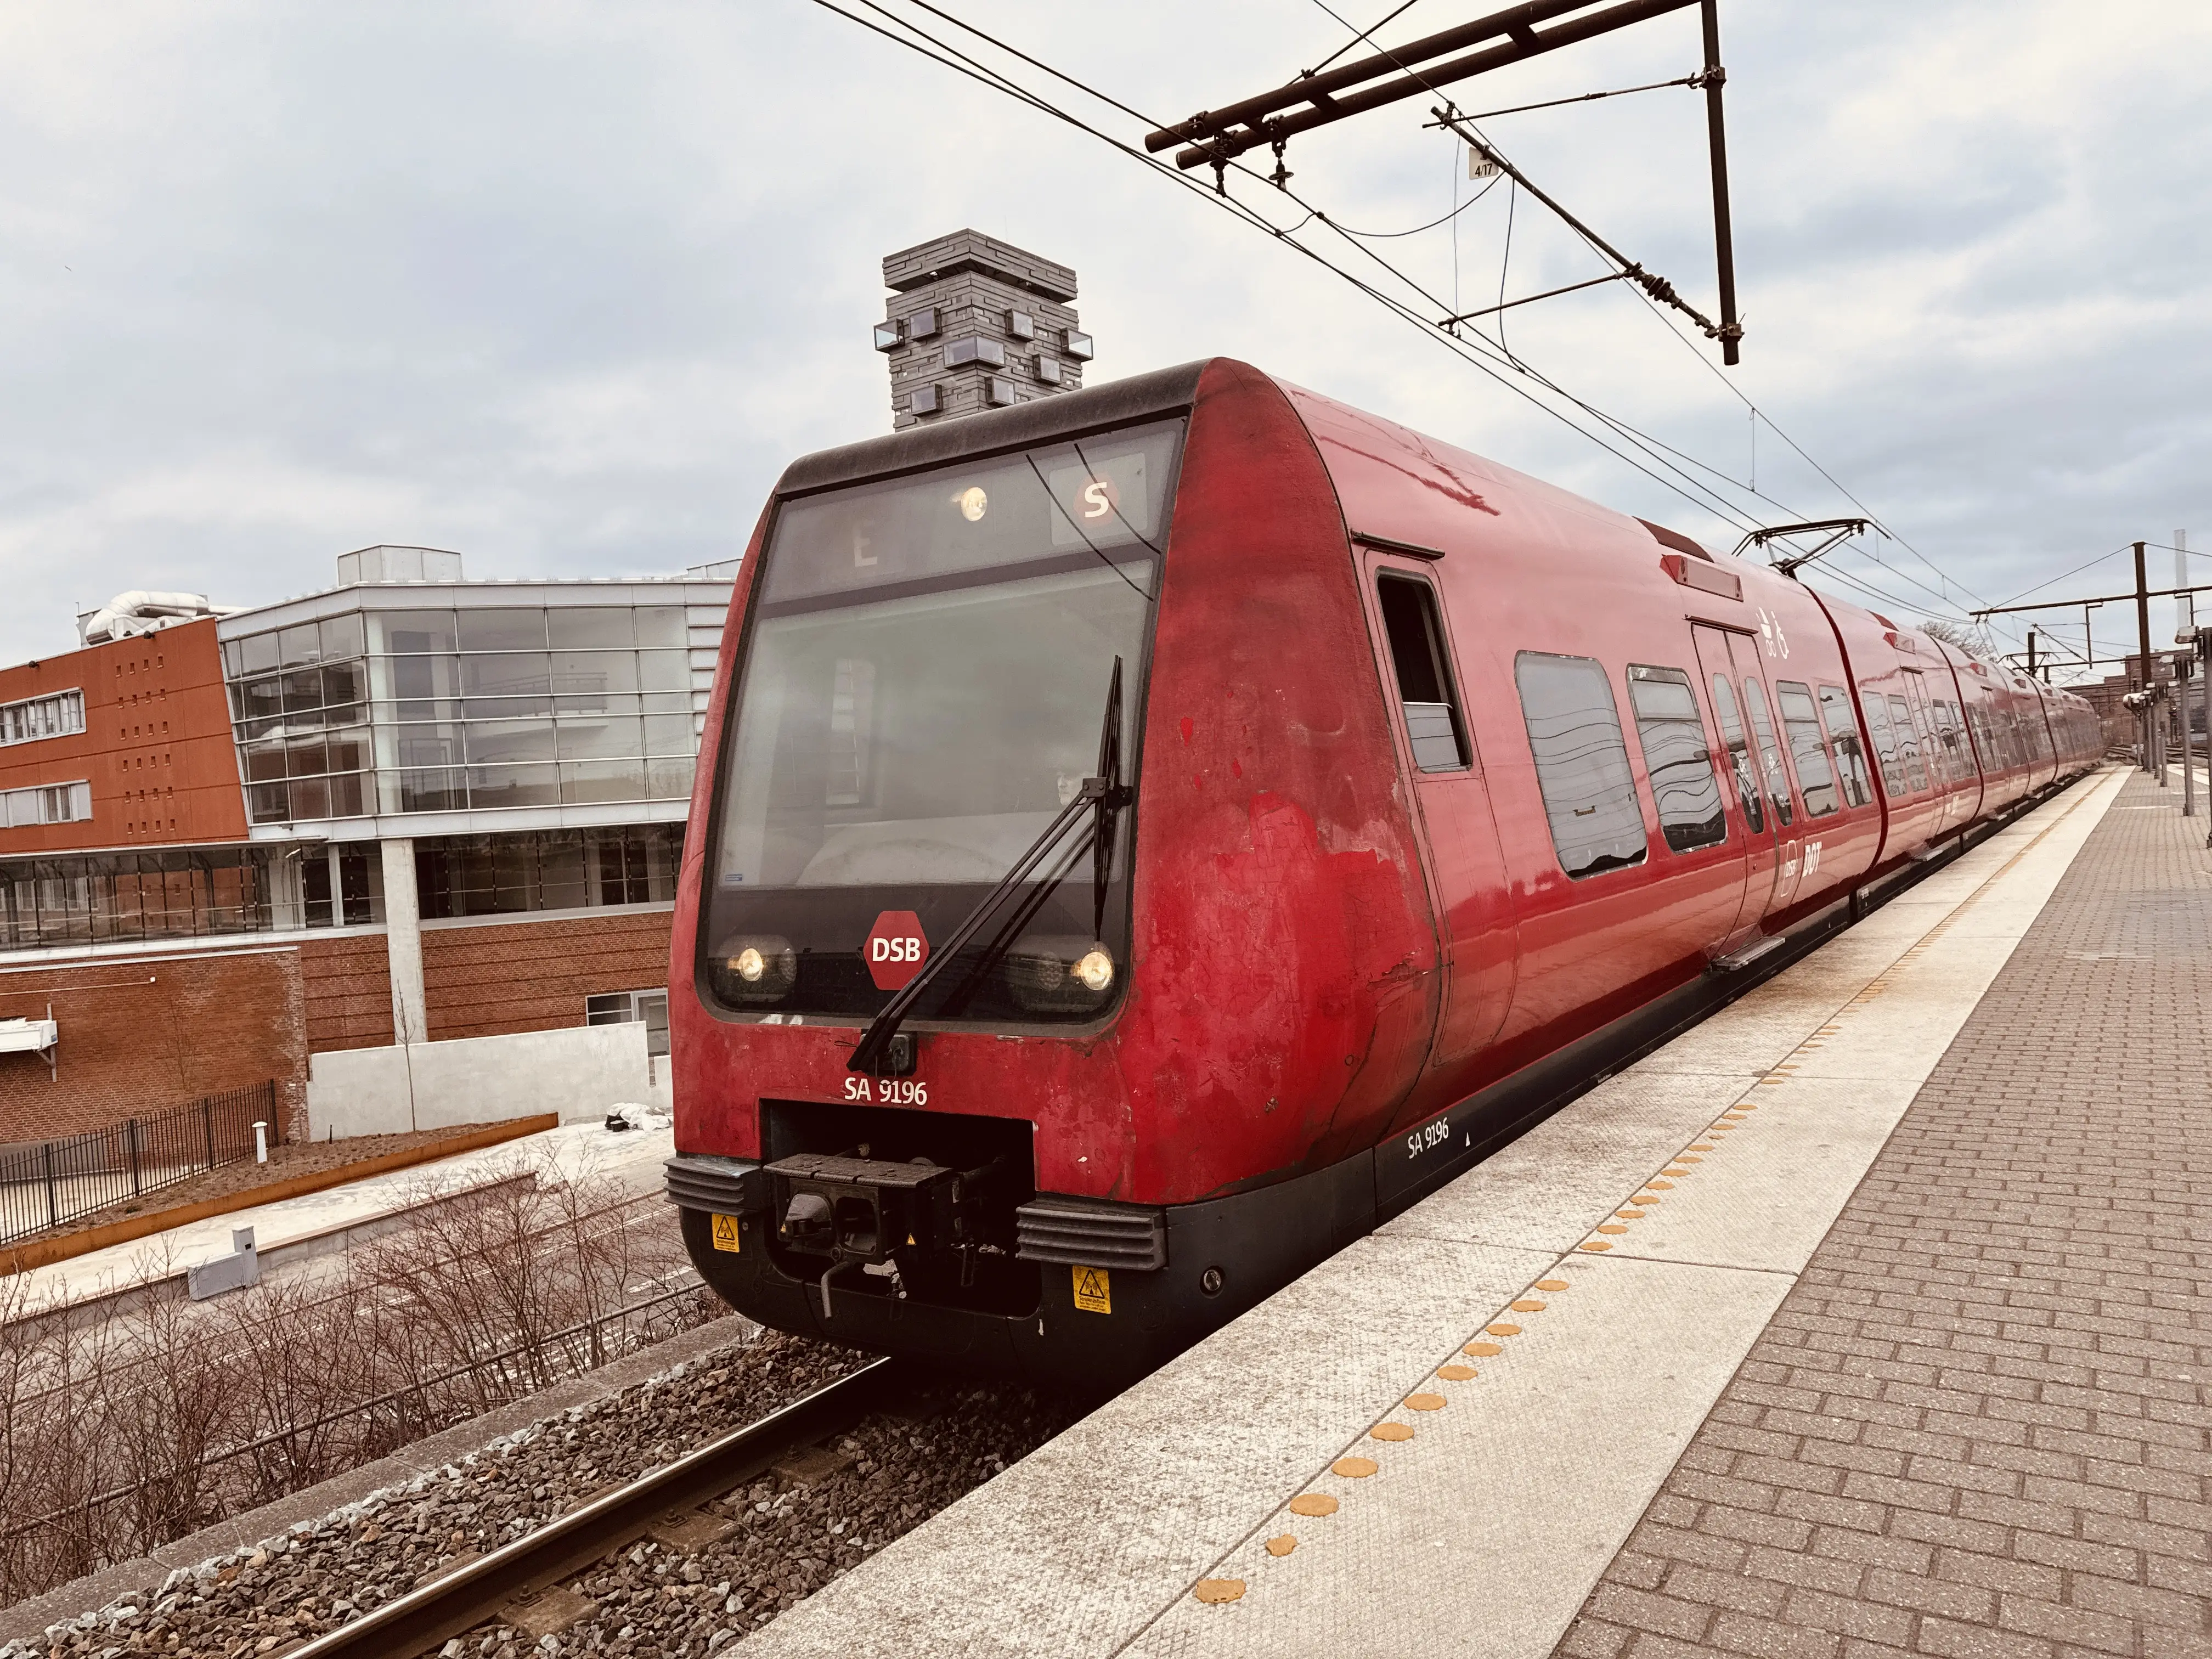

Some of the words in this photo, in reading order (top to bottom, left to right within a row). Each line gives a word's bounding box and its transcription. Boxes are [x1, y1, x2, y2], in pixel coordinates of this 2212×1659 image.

[1475, 163, 1493, 177] 4/17
[1085, 482, 1109, 518] S
[872, 937, 921, 962] DSB
[844, 1077, 872, 1102] SA
[879, 1079, 928, 1106] 9196
[1408, 1132, 1423, 1160] SA
[1425, 1116, 1449, 1149] 9196
